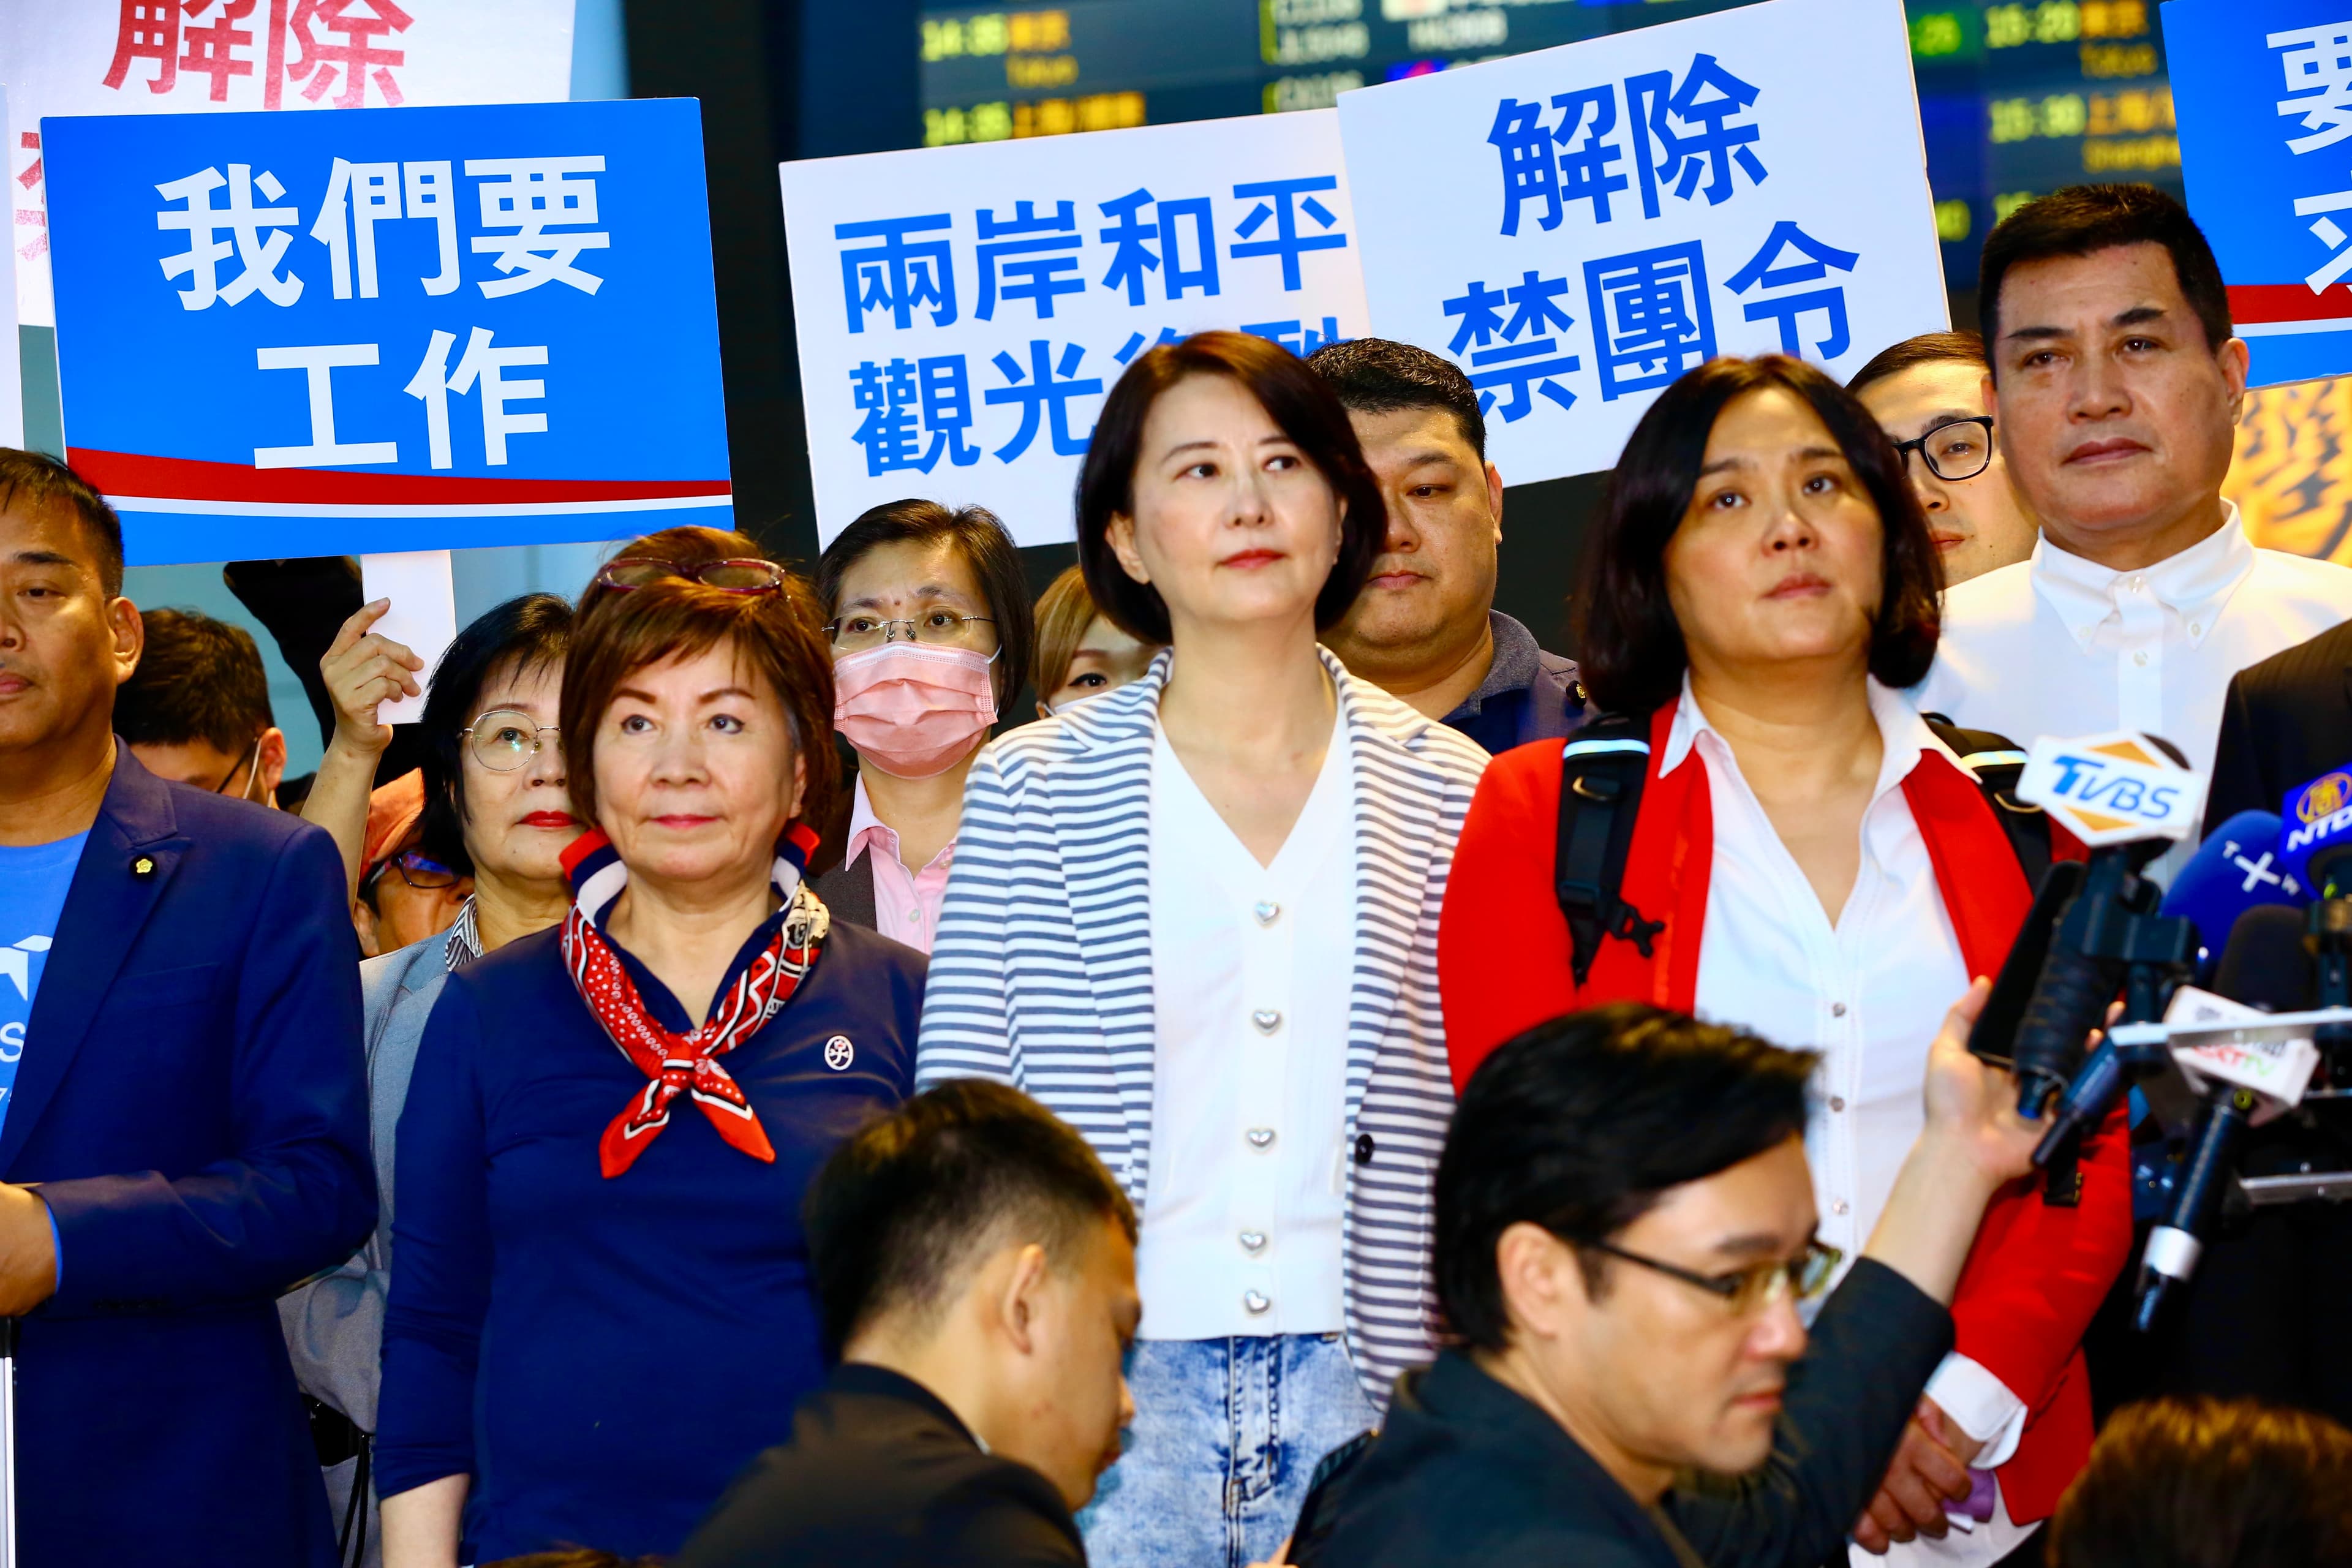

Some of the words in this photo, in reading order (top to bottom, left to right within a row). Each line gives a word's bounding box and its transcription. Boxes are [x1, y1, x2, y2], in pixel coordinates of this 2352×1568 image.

[102, 0, 414, 110] 解除
[1487, 53, 1769, 236] 解除
[155, 155, 611, 311] 我們要
[834, 175, 1346, 334] 兩岸和平
[254, 326, 549, 470] 工作
[850, 317, 1355, 478] 觀光
[1442, 221, 1860, 424] 禁團令
[2051, 755, 2180, 819] TVBS
